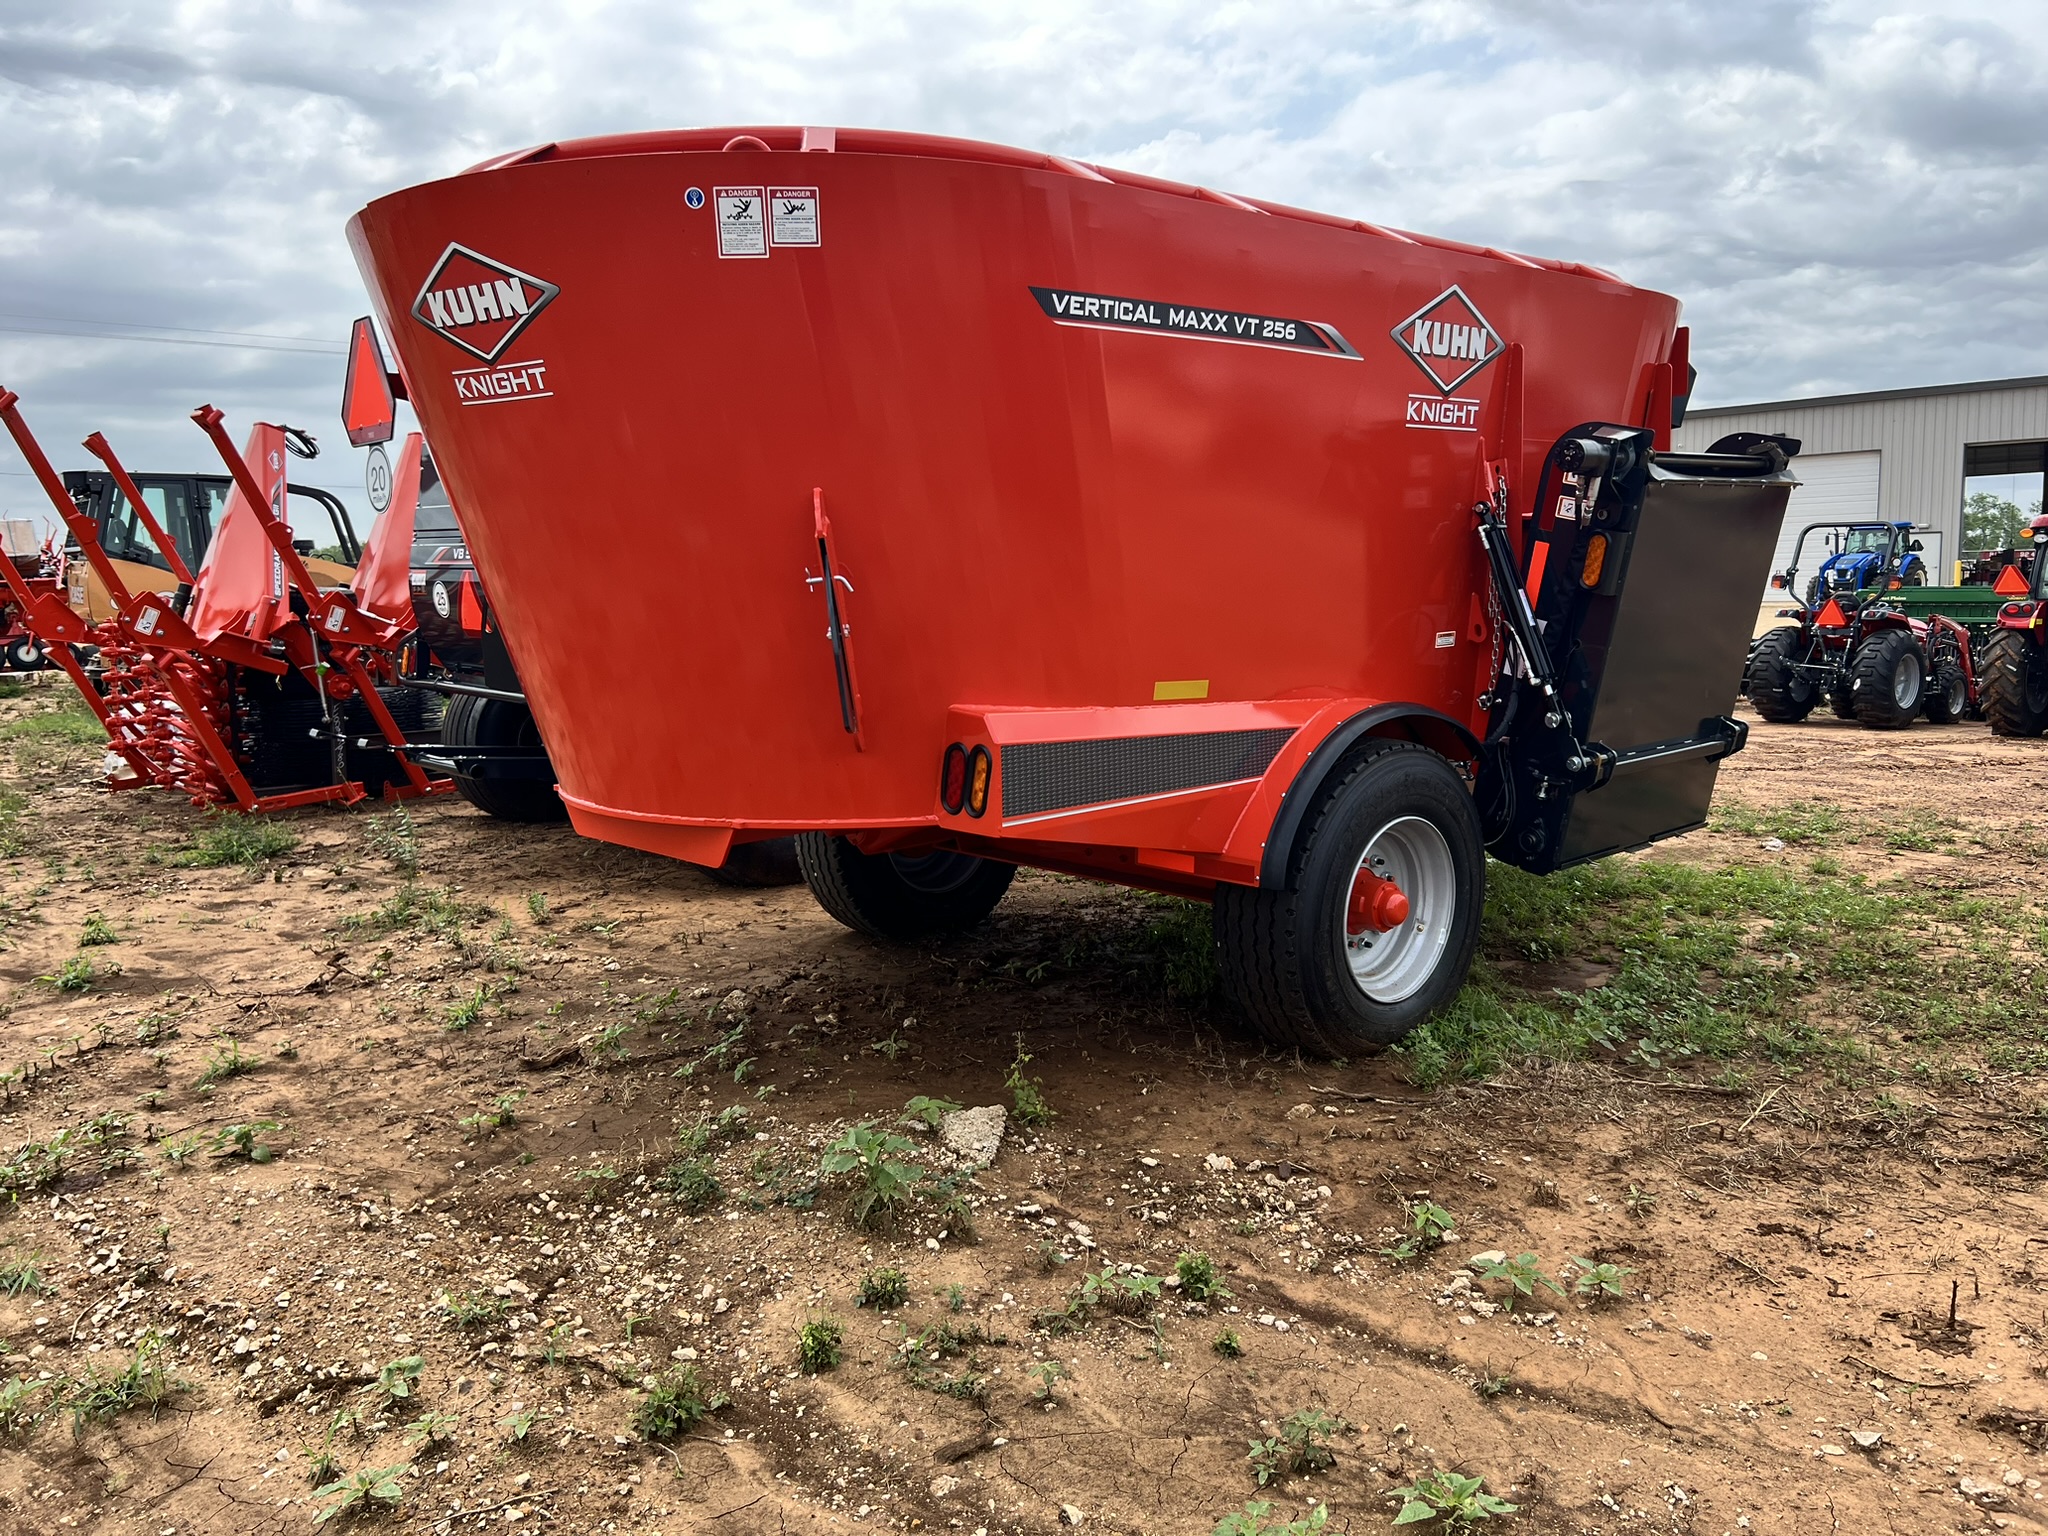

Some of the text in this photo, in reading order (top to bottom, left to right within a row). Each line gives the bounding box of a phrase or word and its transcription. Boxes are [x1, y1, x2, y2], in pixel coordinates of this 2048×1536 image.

[426, 277, 530, 328] KUHN
[1051, 293, 1296, 340] VERTICAL MAXX VT 256
[1412, 318, 1488, 362] KUHN
[454, 366, 547, 399] KNIGHT
[1406, 400, 1479, 425] KNIGHT
[371, 465, 386, 493] 20
[453, 548, 464, 560] VB
[436, 591, 446, 606] 25
